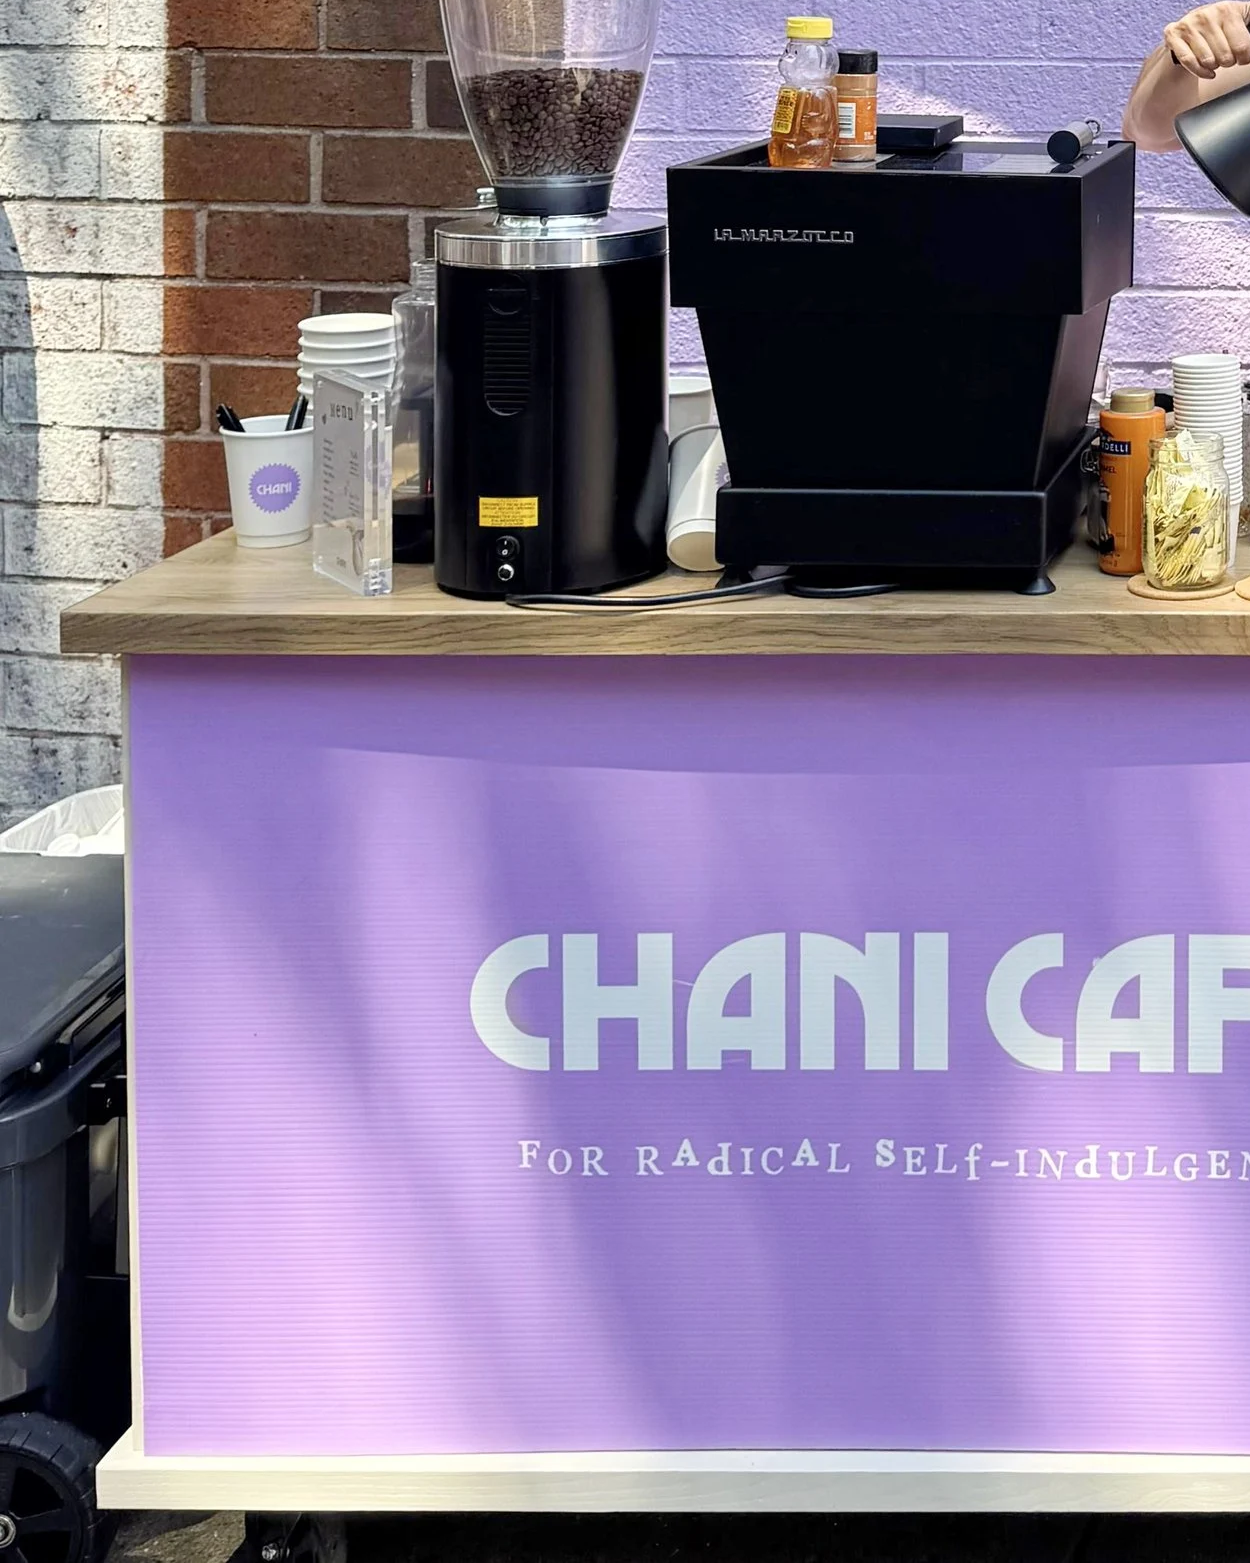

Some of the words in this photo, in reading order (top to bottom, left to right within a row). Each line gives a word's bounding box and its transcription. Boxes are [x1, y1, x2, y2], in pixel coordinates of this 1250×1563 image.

[741, 228, 854, 244] MARZOCCO
[1102, 442, 1128, 453] DELLI
[256, 481, 292, 495] CHANI
[470, 932, 949, 1071] CHANI
[518, 1140, 608, 1177] FOR
